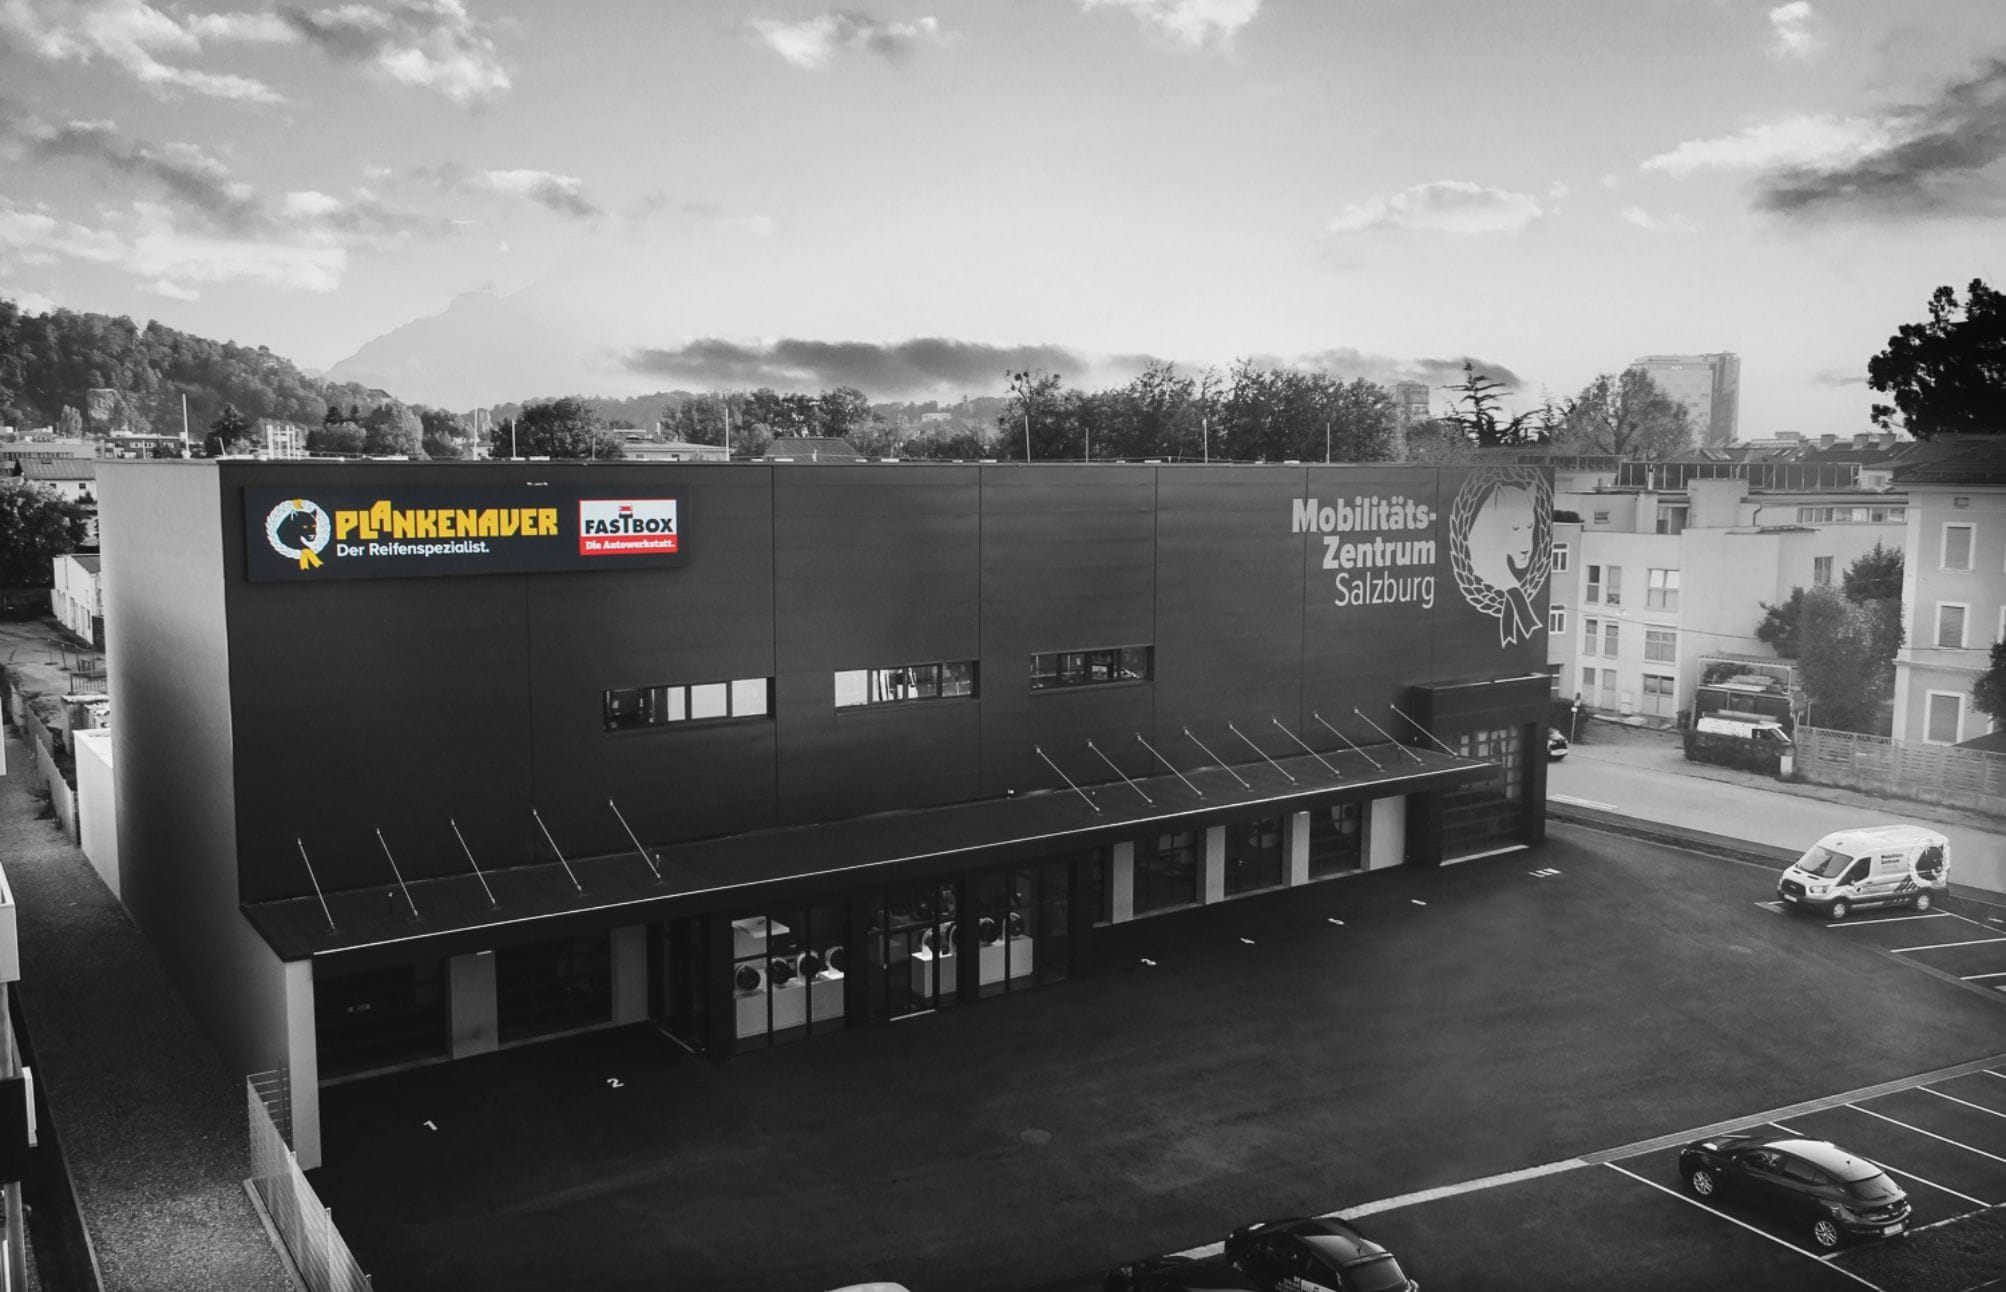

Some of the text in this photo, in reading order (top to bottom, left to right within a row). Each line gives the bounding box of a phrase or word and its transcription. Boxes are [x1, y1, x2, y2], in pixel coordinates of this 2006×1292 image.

[585, 513, 673, 534] FASTBOX
[1292, 495, 1437, 533] Mobilitäts-
[336, 540, 490, 557] Der Reifenspezialist.
[1322, 535, 1436, 569] Zentrum
[1334, 570, 1435, 609] Salzburg
[606, 1077, 624, 1088] 2
[423, 1120, 438, 1131] 1
